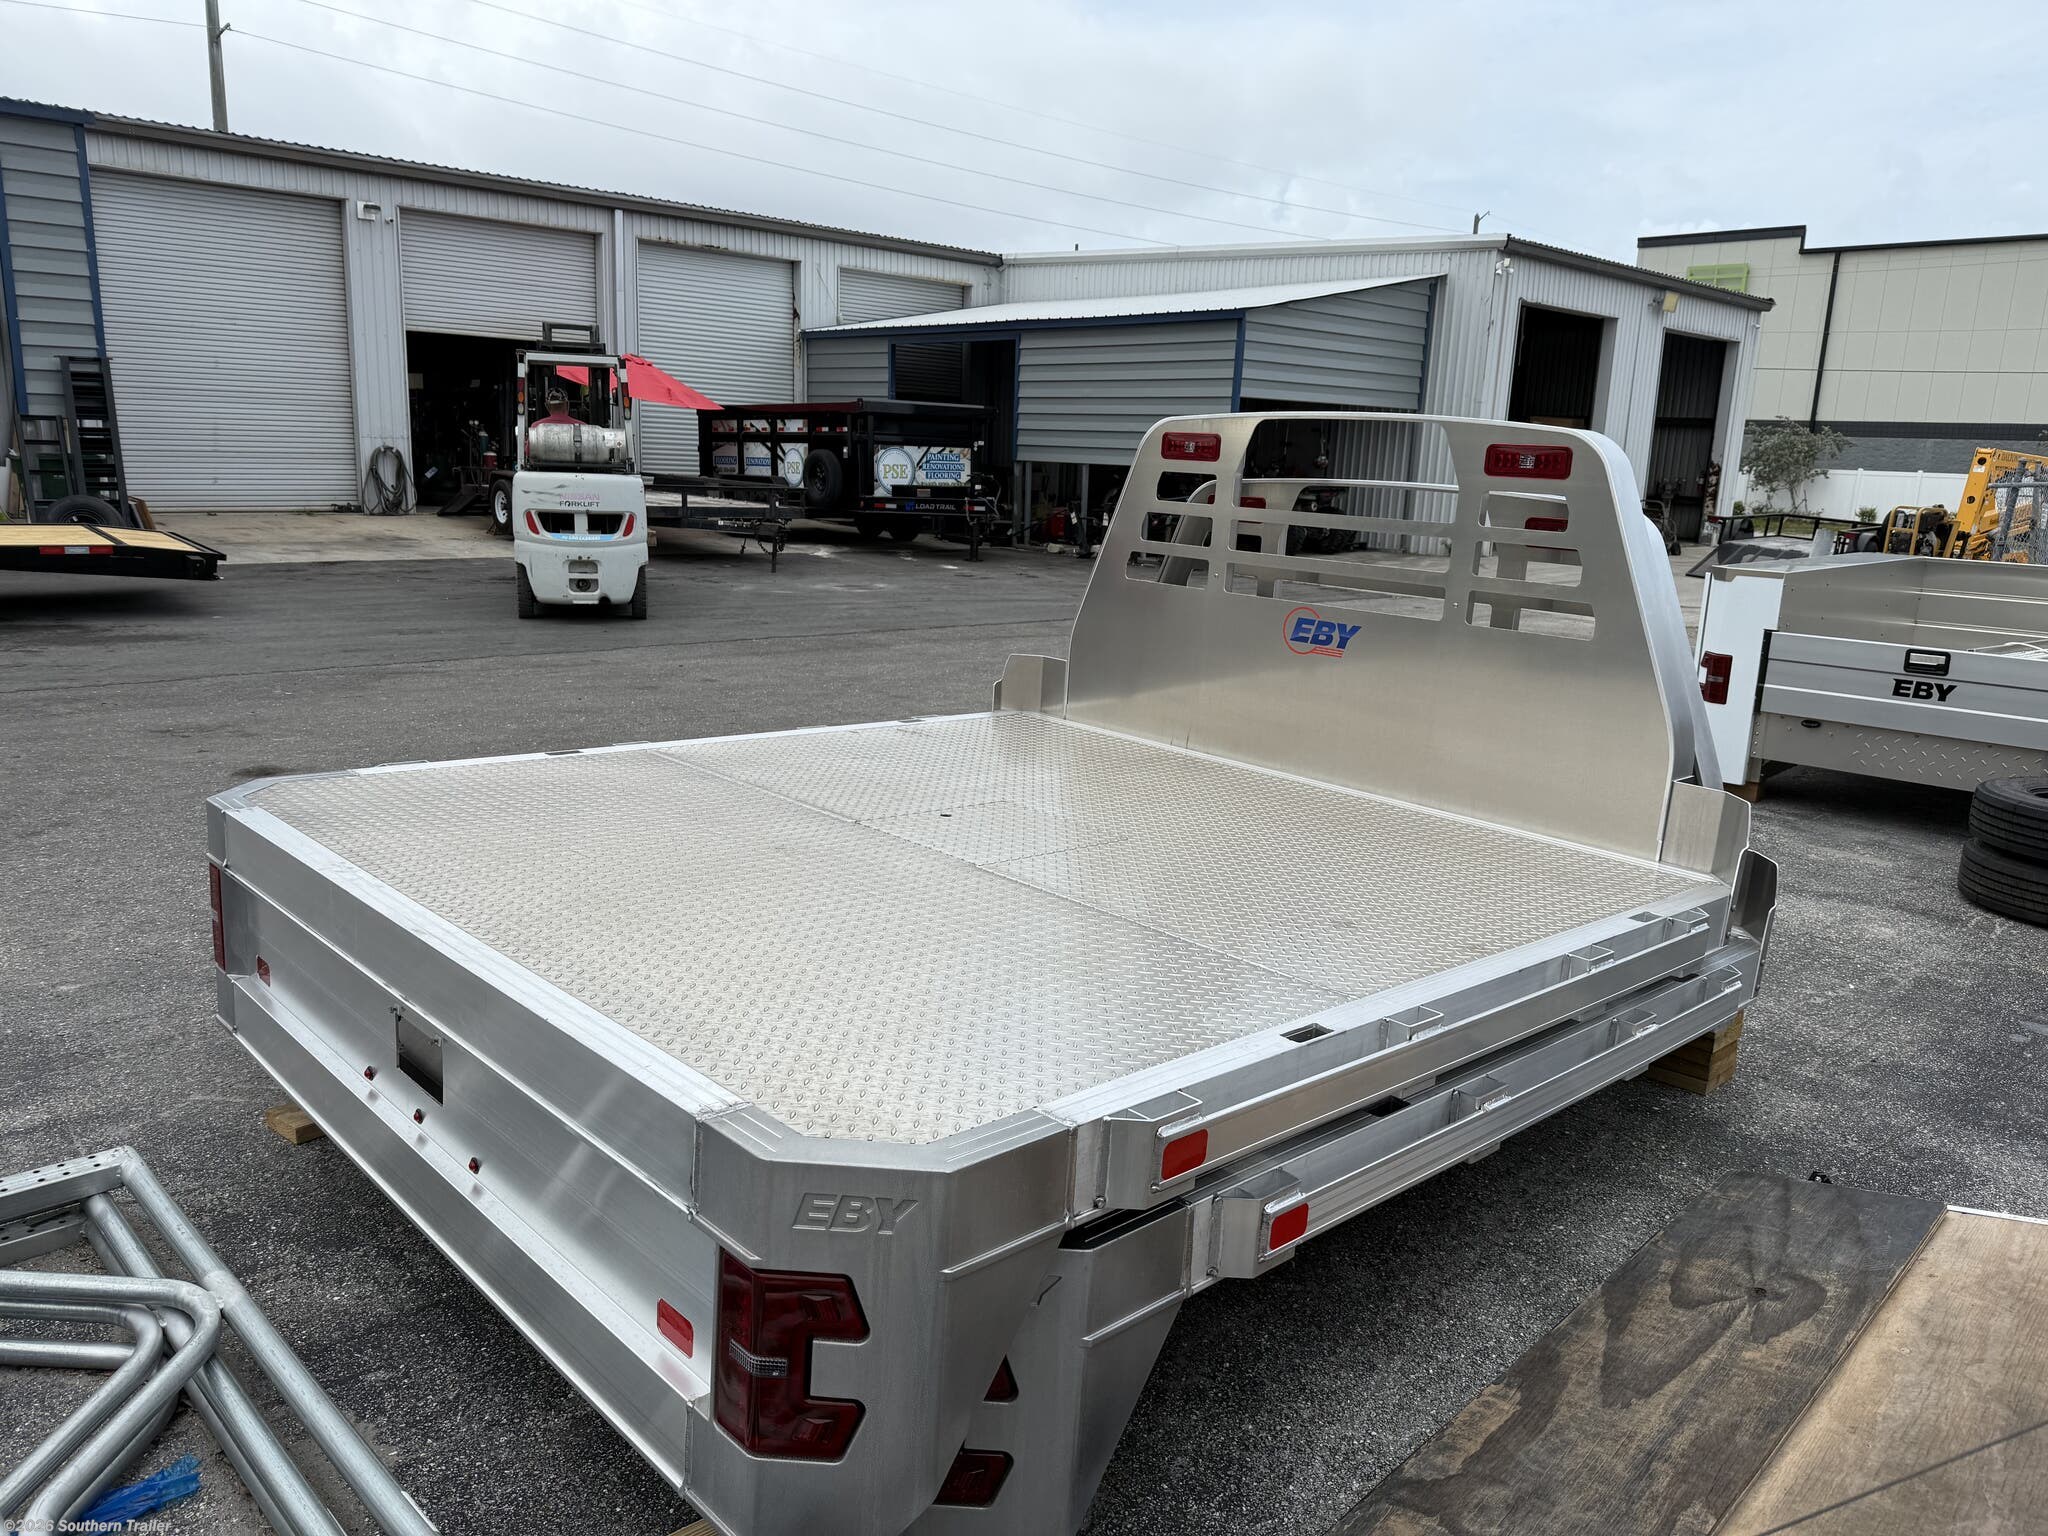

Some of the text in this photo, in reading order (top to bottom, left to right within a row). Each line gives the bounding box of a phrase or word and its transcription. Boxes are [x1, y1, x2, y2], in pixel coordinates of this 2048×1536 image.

[927, 453, 960, 462] PAINTING
[786, 461, 801, 474] PSE
[882, 464, 908, 479] PSE
[922, 463, 965, 471] RENOVATIONS
[1290, 617, 1361, 649] EBY
[1892, 679, 1957, 702] EBY
[792, 1193, 919, 1235] EBY
